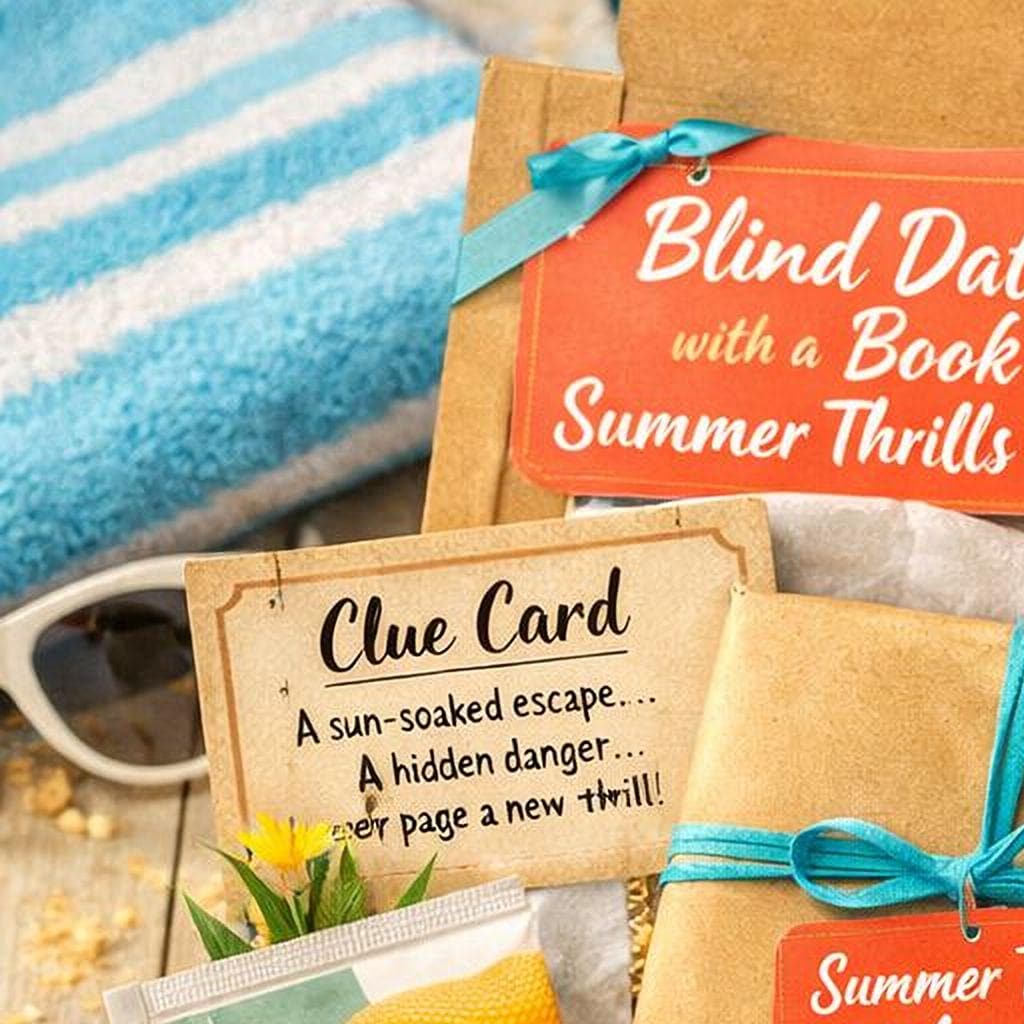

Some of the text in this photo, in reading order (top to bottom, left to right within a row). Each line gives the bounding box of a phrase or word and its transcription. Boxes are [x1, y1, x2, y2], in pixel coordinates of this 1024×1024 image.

[637, 194, 882, 291] Blind
[671, 305, 1022, 385] with a Book
[554, 377, 811, 459] Summer
[824, 397, 1017, 475] Thrills
[320, 566, 630, 673] Clue Card
[297, 708, 320, 747] A
[330, 687, 504, 740] sun-soaked
[359, 736, 644, 793] A hidden danger...
[400, 805, 468, 848] page
[481, 803, 499, 827] a
[505, 793, 565, 826] new
[811, 952, 1003, 1015] Summer
